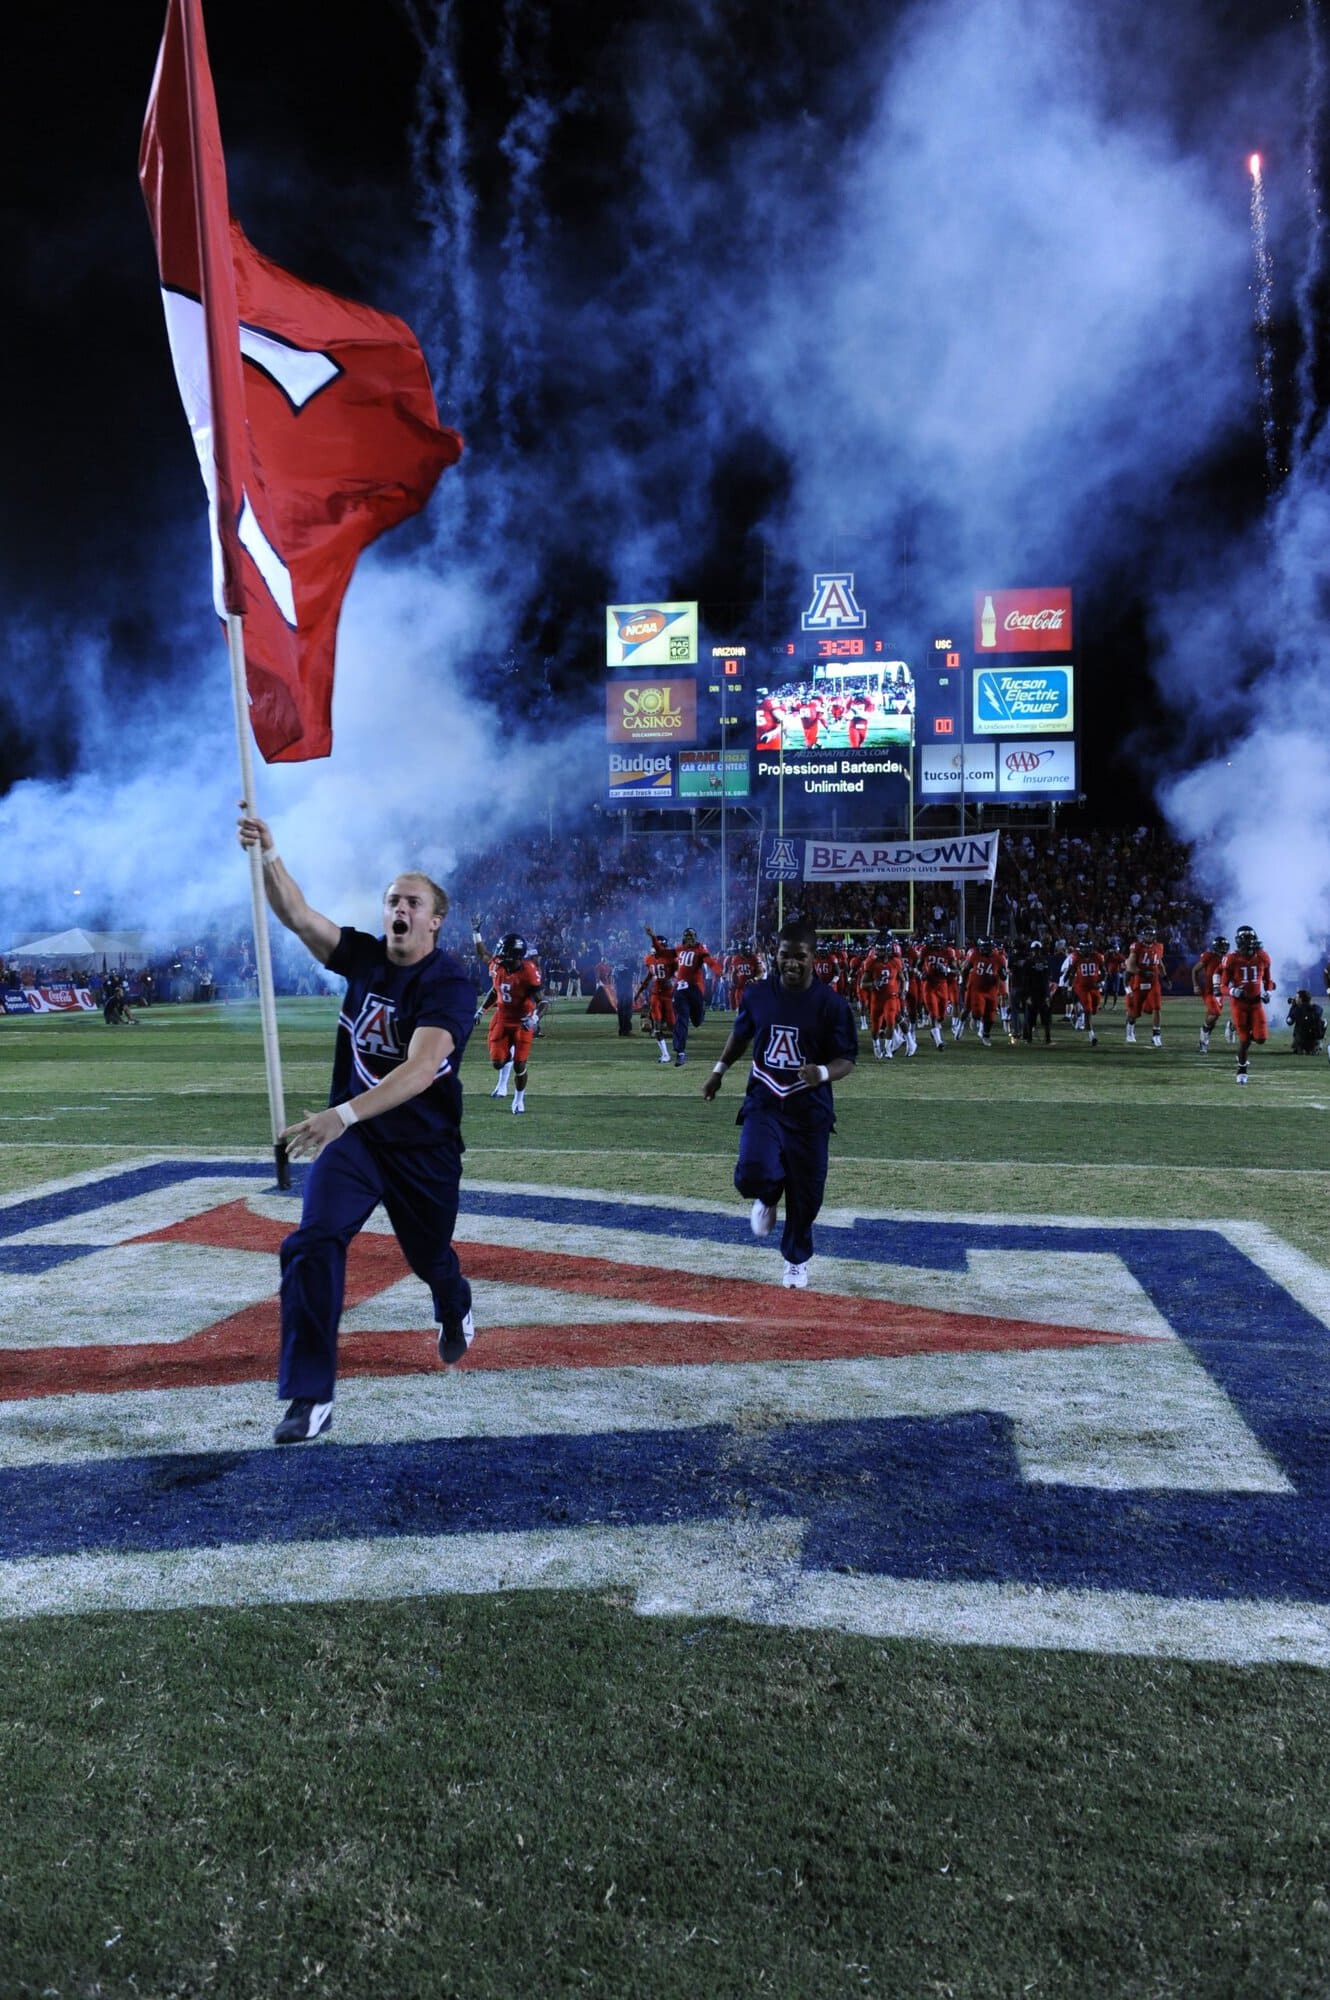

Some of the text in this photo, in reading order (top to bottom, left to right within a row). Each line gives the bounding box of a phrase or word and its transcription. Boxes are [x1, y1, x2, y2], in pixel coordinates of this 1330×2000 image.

[802, 573, 867, 631] A
[1004, 609, 1066, 631] Coca-Cola
[625, 622, 658, 637] NCAA
[712, 647, 746, 656] ARIZONA
[787, 643, 794, 655] 3
[818, 639, 864, 656] 3:28
[875, 640, 882, 652] 3
[935, 640, 952, 649] USC
[946, 653, 959, 667] 0
[725, 661, 737, 674] 0
[1001, 677, 1047, 690] Tucson
[623, 688, 681, 716] SOL
[1005, 689, 1060, 701] Electric
[1011, 701, 1060, 713] Power
[623, 715, 682, 729] CASINOS
[609, 754, 672, 776] Budget
[681, 763, 695, 772] CAR
[717, 762, 748, 771] CNTERS
[1006, 751, 1039, 772] AAA
[758, 762, 837, 776] Professional
[805, 780, 864, 793] Unlimited
[1023, 775, 1070, 784] Insurance
[766, 839, 798, 870] A
[812, 841, 991, 869] BEARDOWN
[765, 870, 797, 880] CLUB
[1240, 965, 1258, 983] 11
[352, 993, 407, 1060] A
[764, 1025, 805, 1070] A
